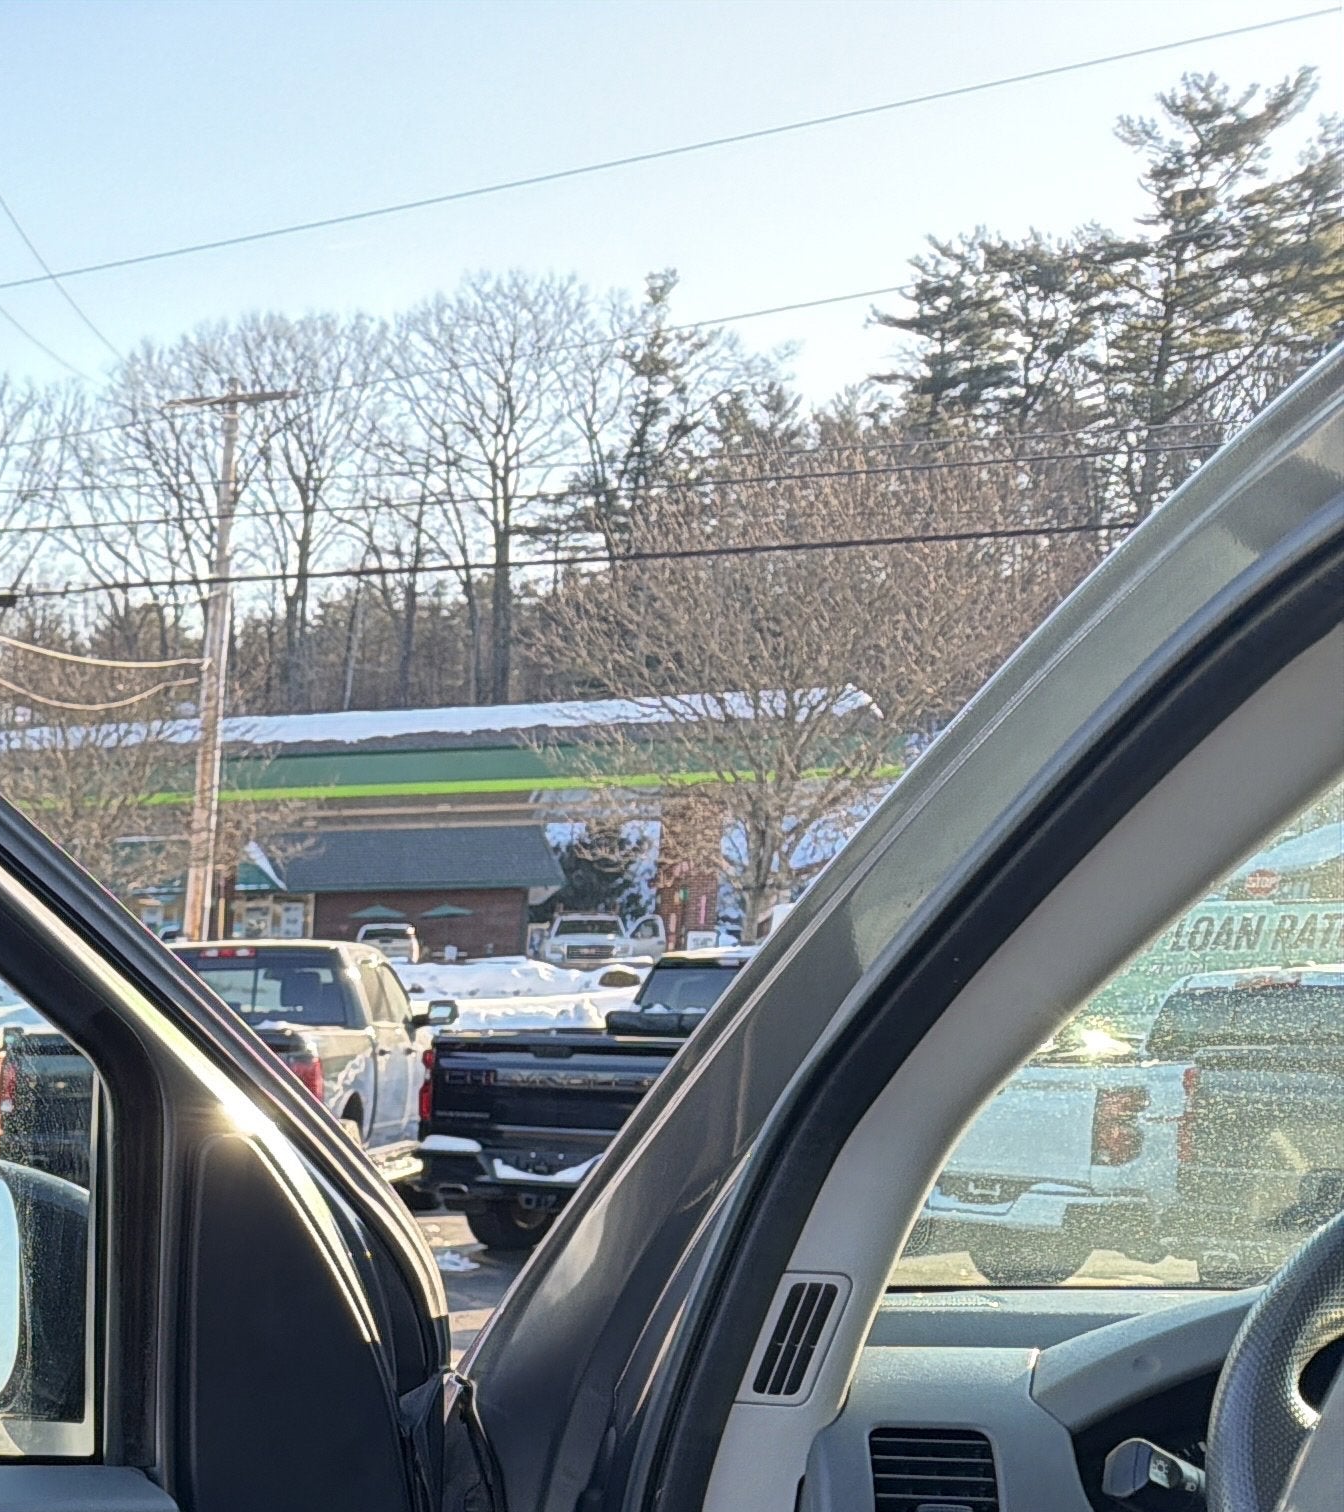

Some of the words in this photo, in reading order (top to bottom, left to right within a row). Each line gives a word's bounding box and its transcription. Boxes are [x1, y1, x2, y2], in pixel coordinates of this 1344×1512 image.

[1246, 875, 1276, 888] STOP
[1169, 914, 1267, 951] LOAN
[1271, 912, 1344, 951] RAT
